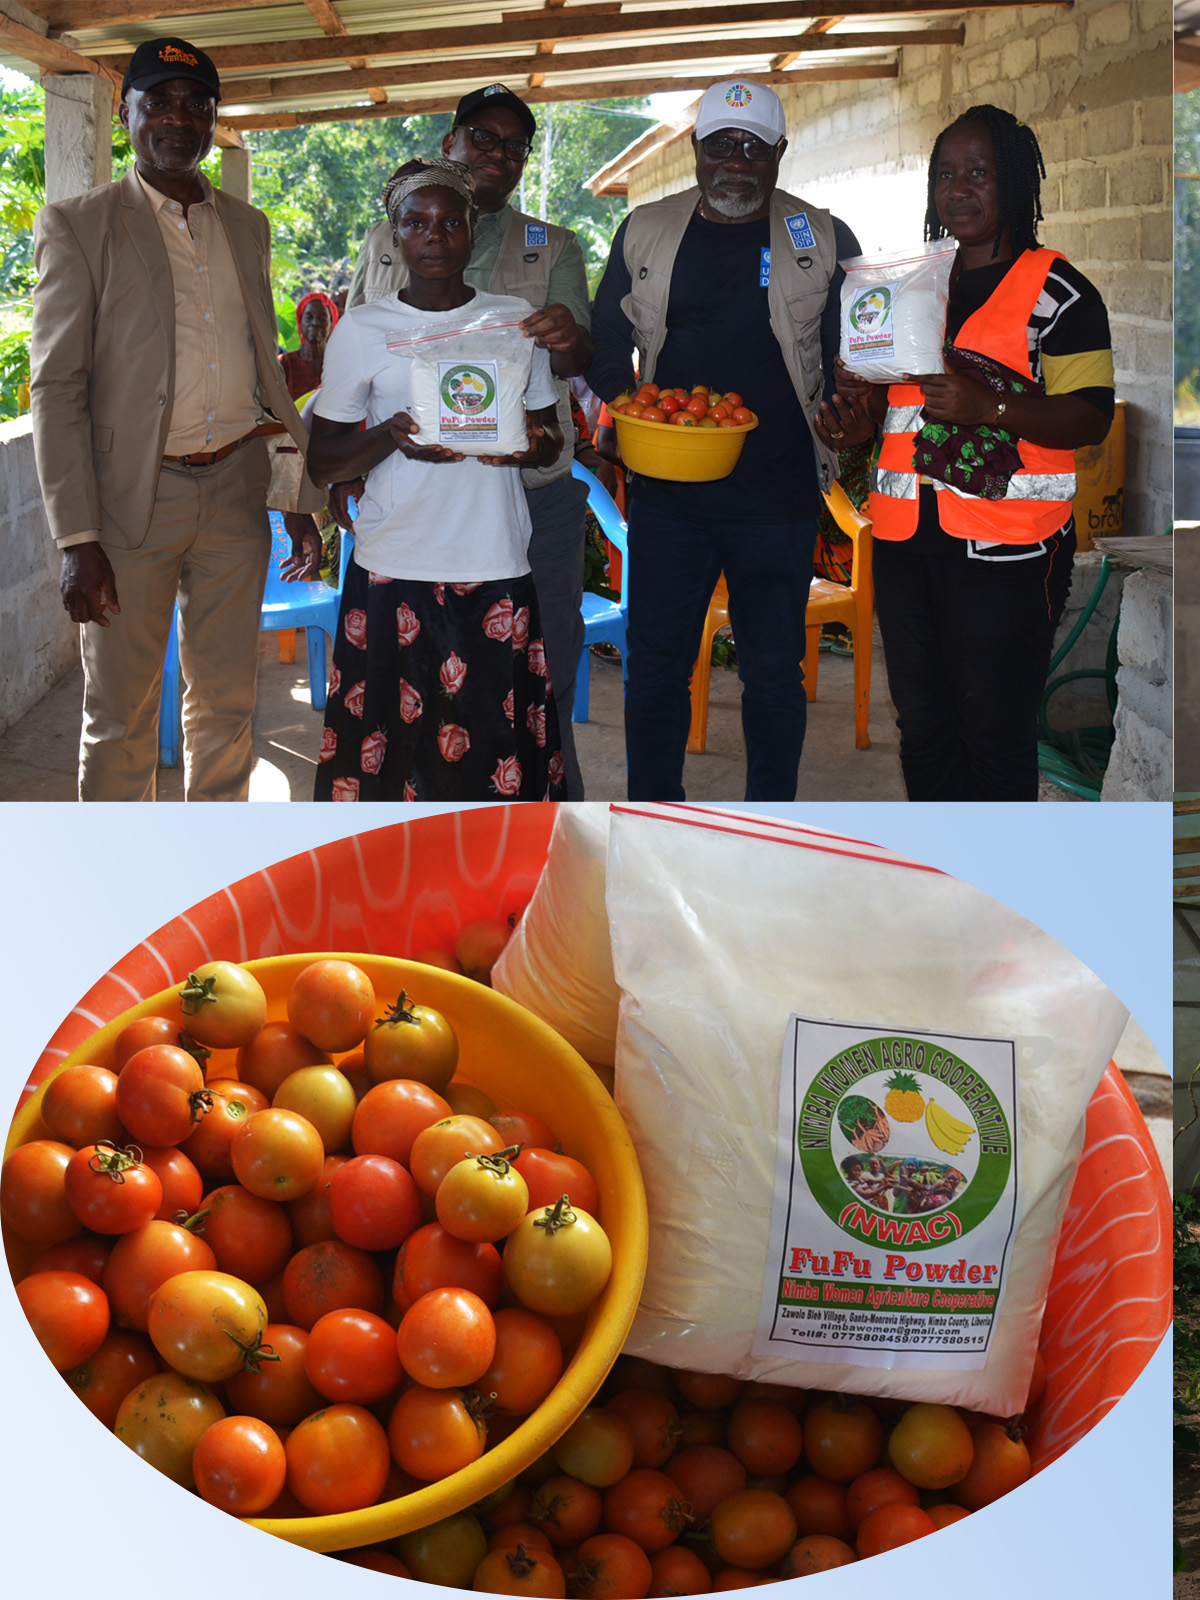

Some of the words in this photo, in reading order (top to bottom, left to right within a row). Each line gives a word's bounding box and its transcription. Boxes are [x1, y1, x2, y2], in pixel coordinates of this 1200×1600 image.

[793, 230, 810, 240] UN
[796, 240, 812, 248] DP
[866, 332, 892, 341] Powder
[817, 1044, 879, 1097] WOMEN
[881, 1040, 925, 1070] AGRO
[929, 1051, 1009, 1154] COOPERATIVE
[801, 1093, 836, 1149] NIMBA
[839, 1202, 962, 1245] (NWAC)
[788, 1247, 872, 1279] FuFu
[883, 1254, 998, 1284] Powder
[781, 1279, 820, 1300] Nimba
[822, 1282, 864, 1303] Women
[865, 1286, 930, 1309] Agriculture
[932, 1289, 996, 1312] Cooperative
[781, 1307, 806, 1320] Zawolo
[823, 1310, 848, 1323] Village,
[849, 1312, 898, 1325] Ganta-Monrovia
[900, 1315, 926, 1328] Highway,
[927, 1316, 947, 1326] Nimba
[948, 1317, 970, 1328] County,
[970, 1317, 991, 1327] Liberia
[820, 1322, 961, 1337] nimbawomen@gmail.com
